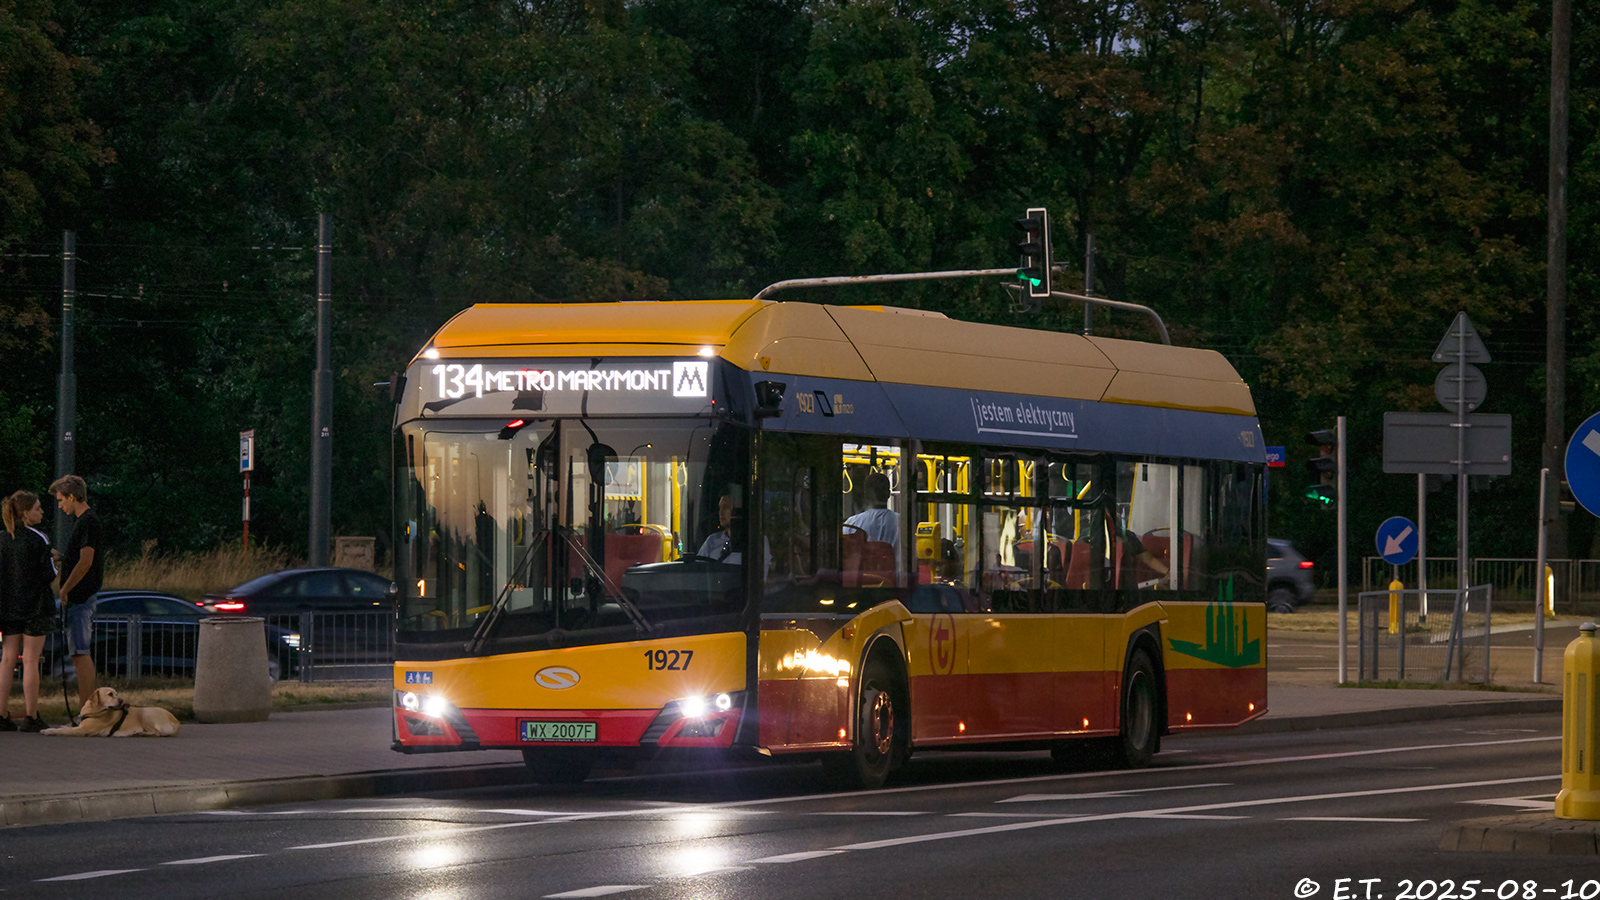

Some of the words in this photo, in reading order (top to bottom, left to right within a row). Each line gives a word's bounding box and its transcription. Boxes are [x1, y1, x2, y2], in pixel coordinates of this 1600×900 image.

[432, 364, 484, 398] 134
[485, 369, 555, 391] METRO
[557, 369, 671, 391] MARYMONT
[796, 392, 815, 414] 1927
[975, 398, 1015, 427] jestem
[1016, 402, 1075, 433] elektryczny
[1241, 431, 1254, 447] 1927
[416, 578, 426, 597] 1
[643, 649, 694, 671] 1927
[529, 723, 547, 738] WX
[551, 723, 593, 738] 2007F
